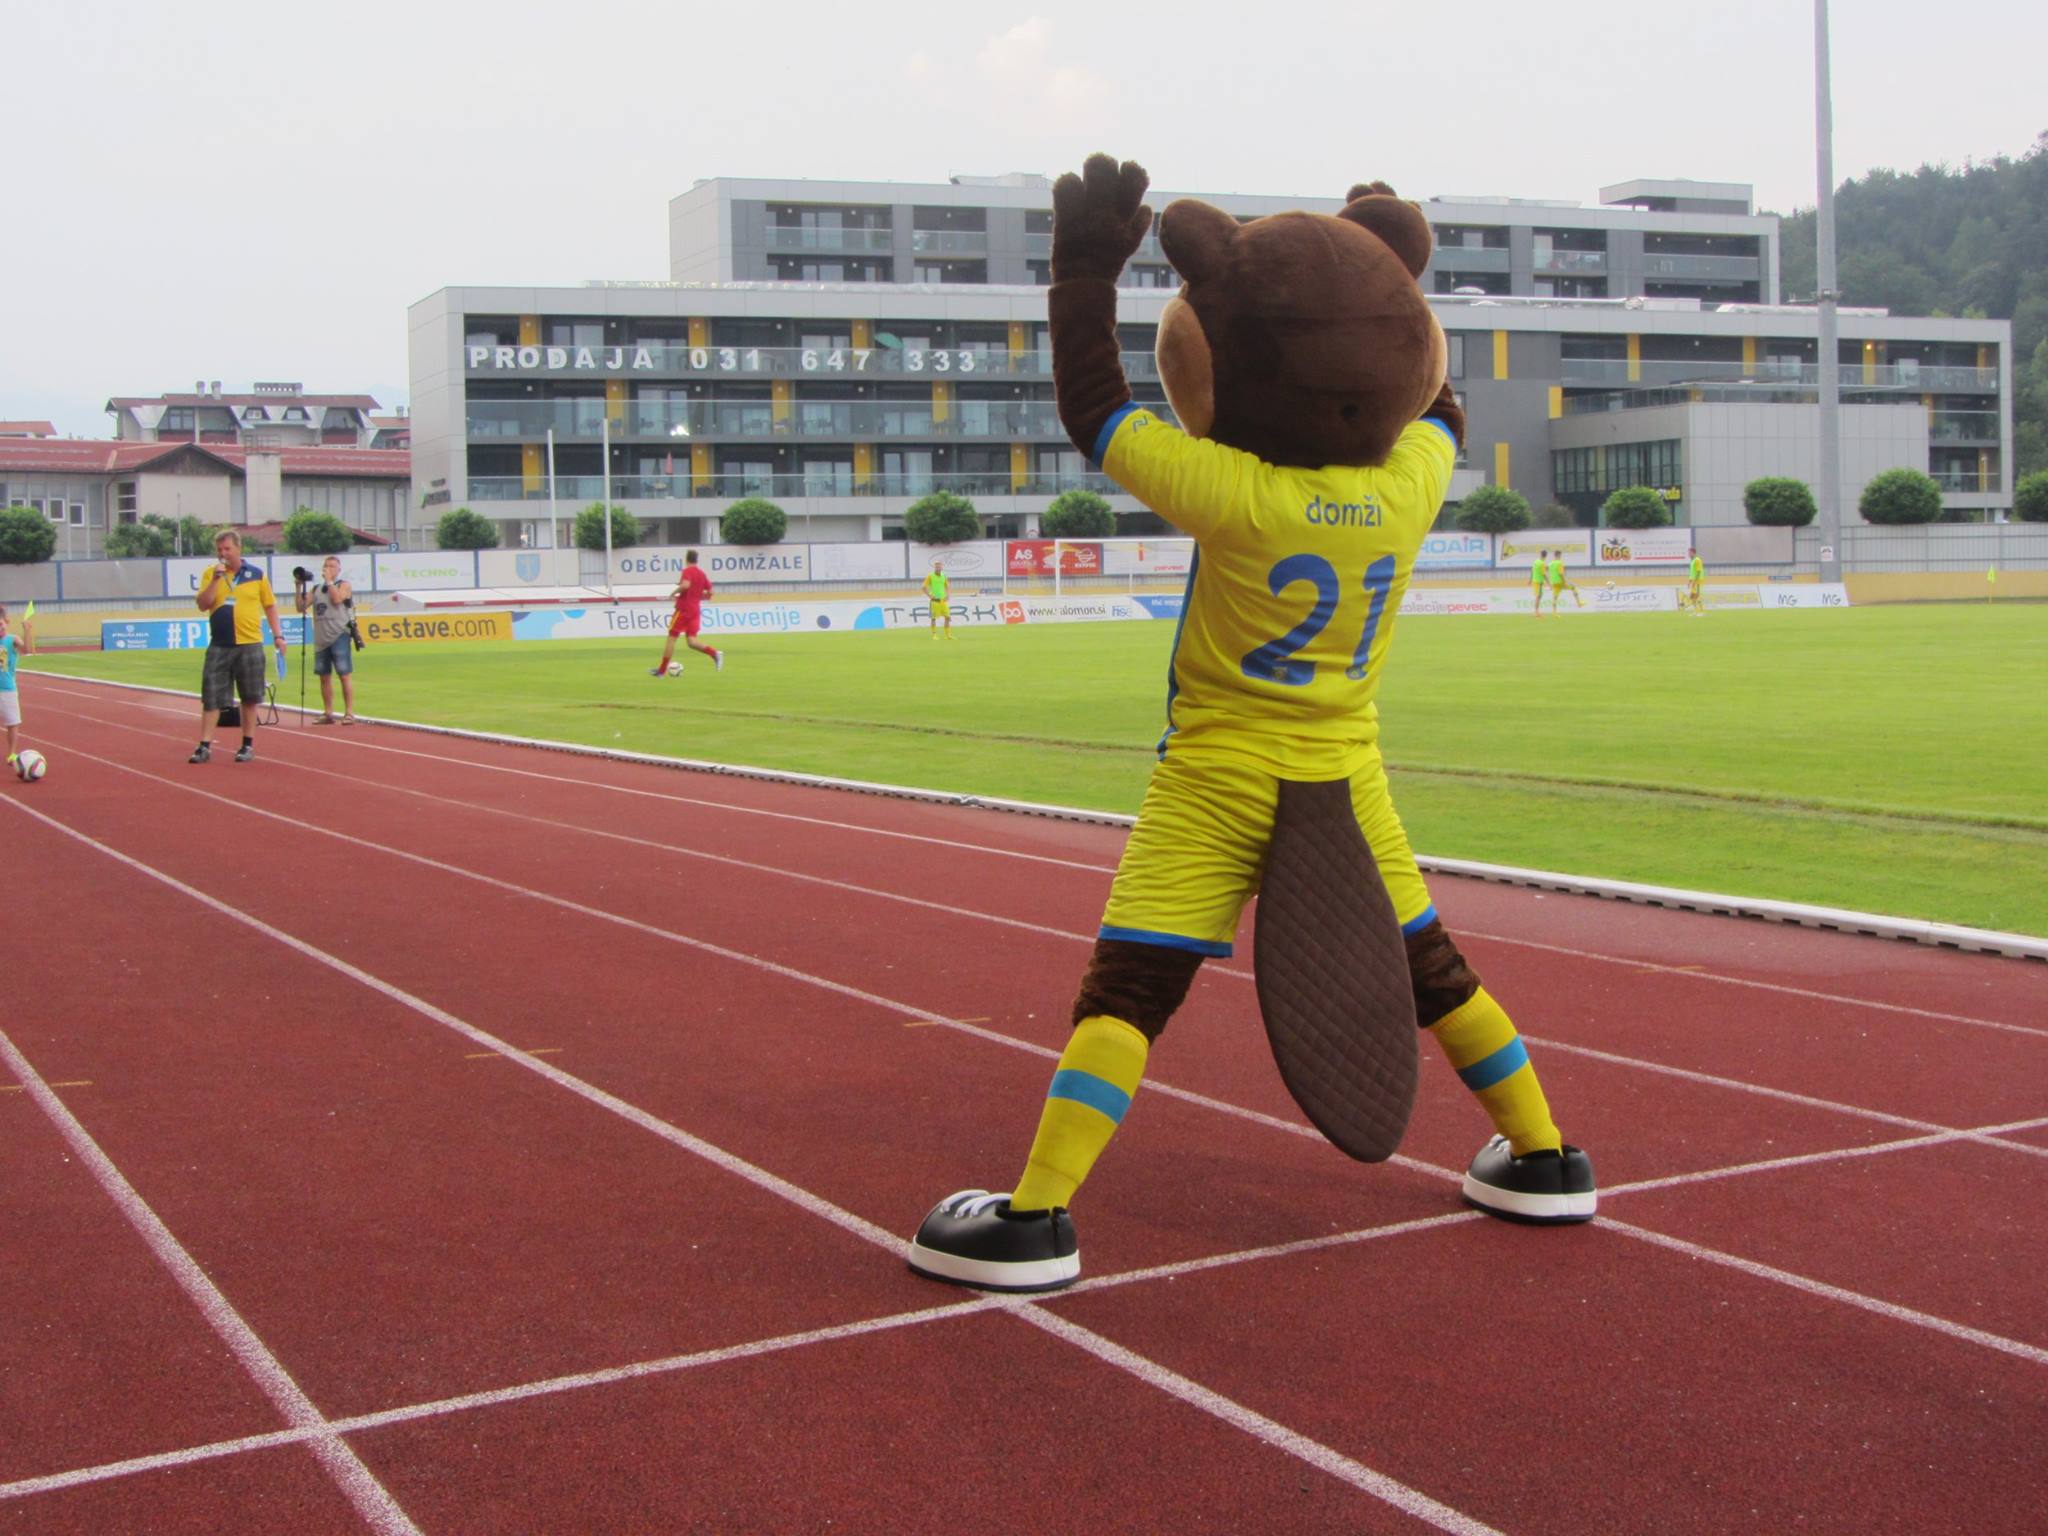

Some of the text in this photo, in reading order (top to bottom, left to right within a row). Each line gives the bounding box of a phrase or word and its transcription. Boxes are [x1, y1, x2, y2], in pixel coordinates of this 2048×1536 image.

[469, 347, 976, 372] PRODAJA 031 647 333
[1305, 495, 1382, 527] domži
[621, 553, 803, 572] OBČIN DOMŽALE
[368, 616, 496, 640] e-stave.com
[604, 606, 800, 631] Teleko Slovenije
[1240, 553, 1396, 686] 21
